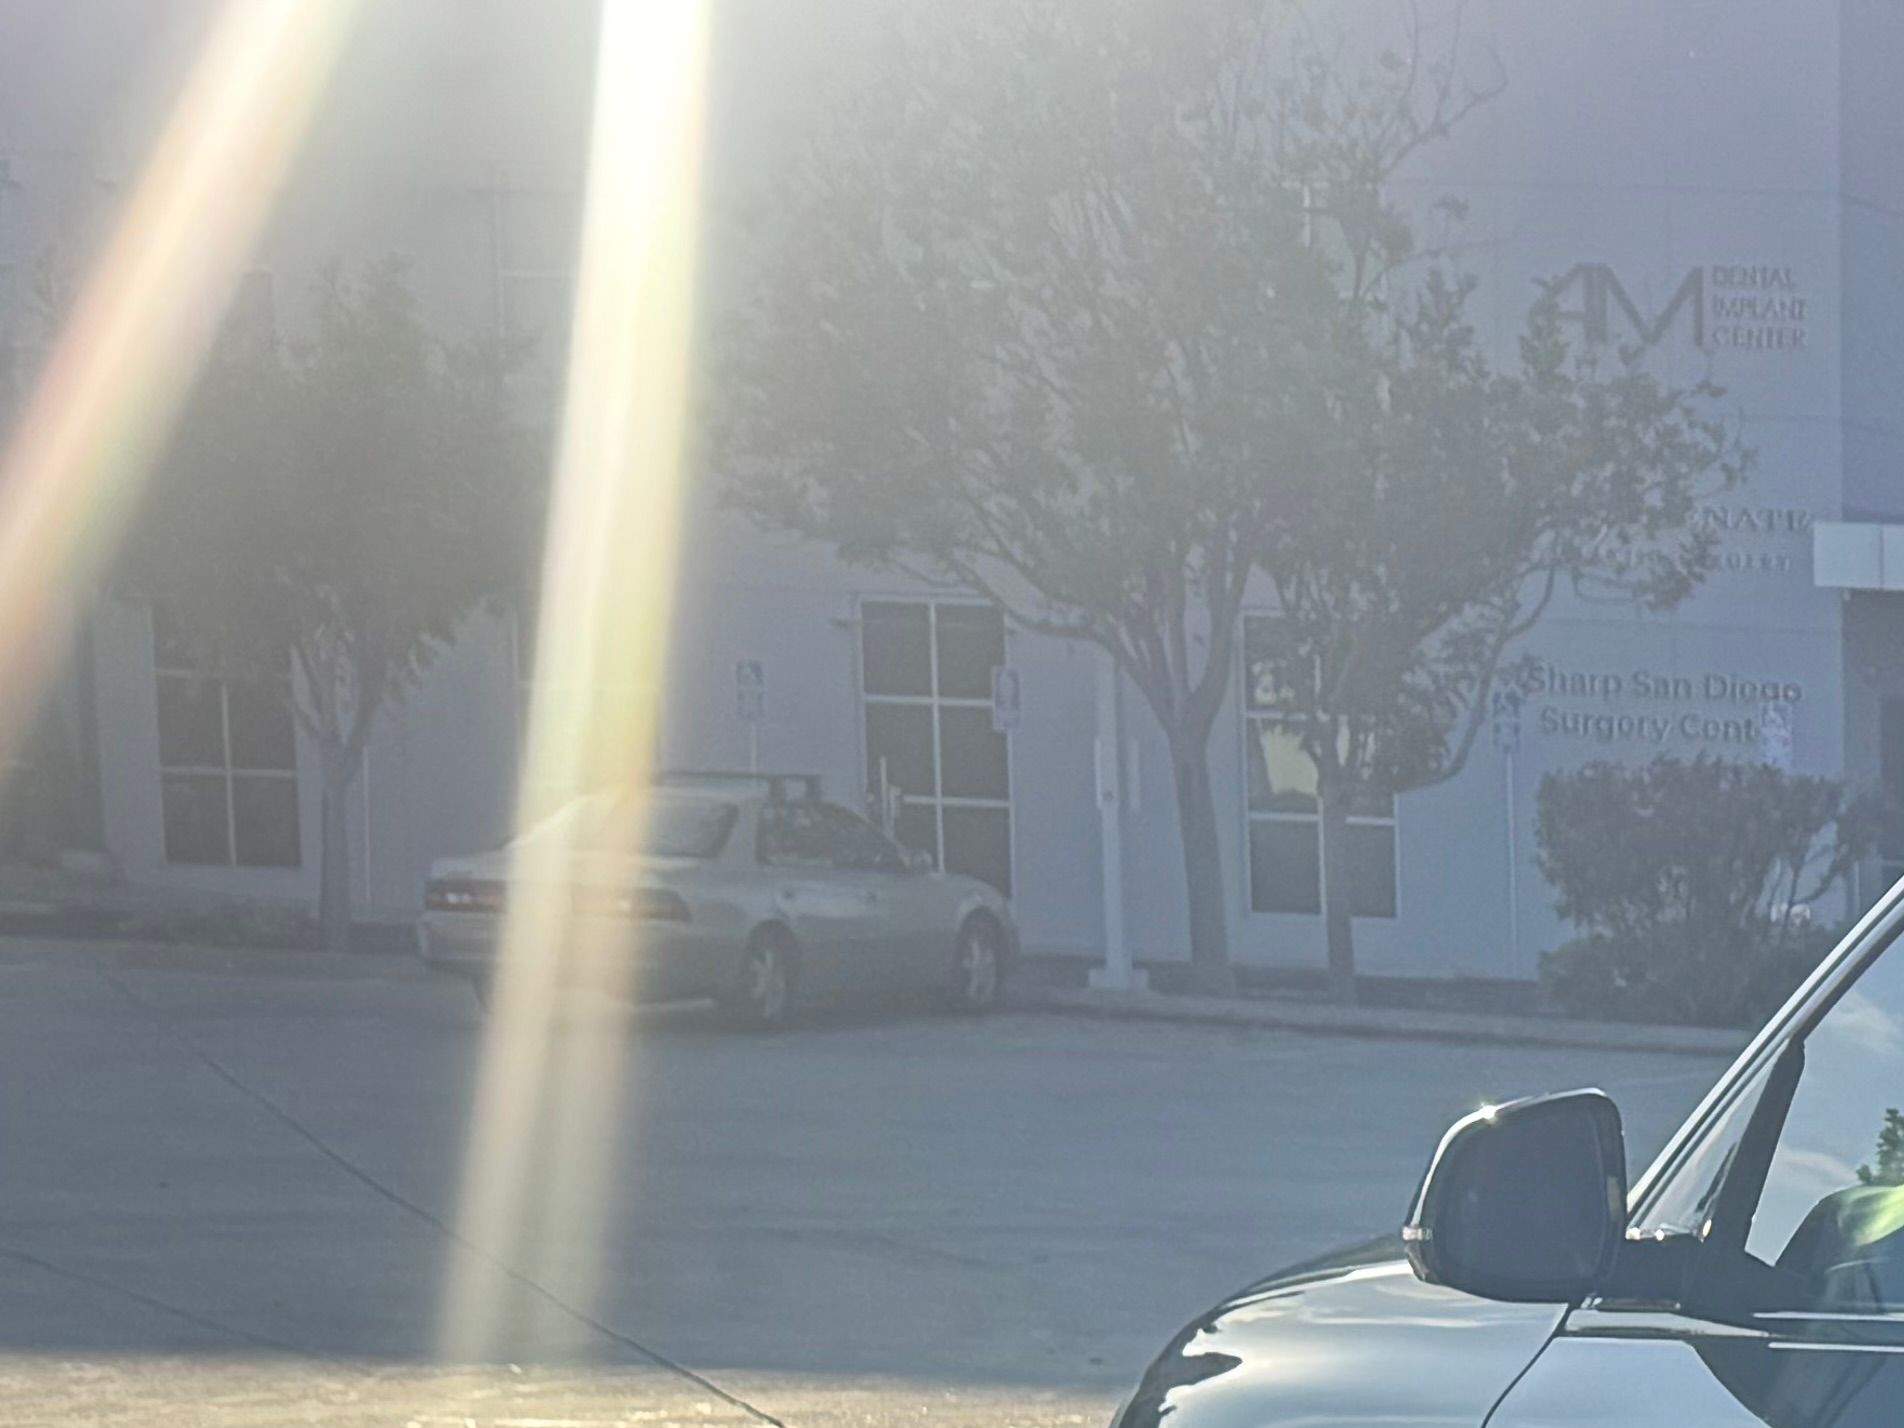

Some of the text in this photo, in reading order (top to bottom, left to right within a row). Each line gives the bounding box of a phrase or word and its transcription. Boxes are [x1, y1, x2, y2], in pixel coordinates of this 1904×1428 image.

[1711, 264, 1796, 288] DENTAL
[1711, 293, 1808, 320] IMPLANT
[1711, 324, 1808, 350] CENTER
[1527, 661, 1622, 701] Sharp
[1631, 668, 1693, 701] San
